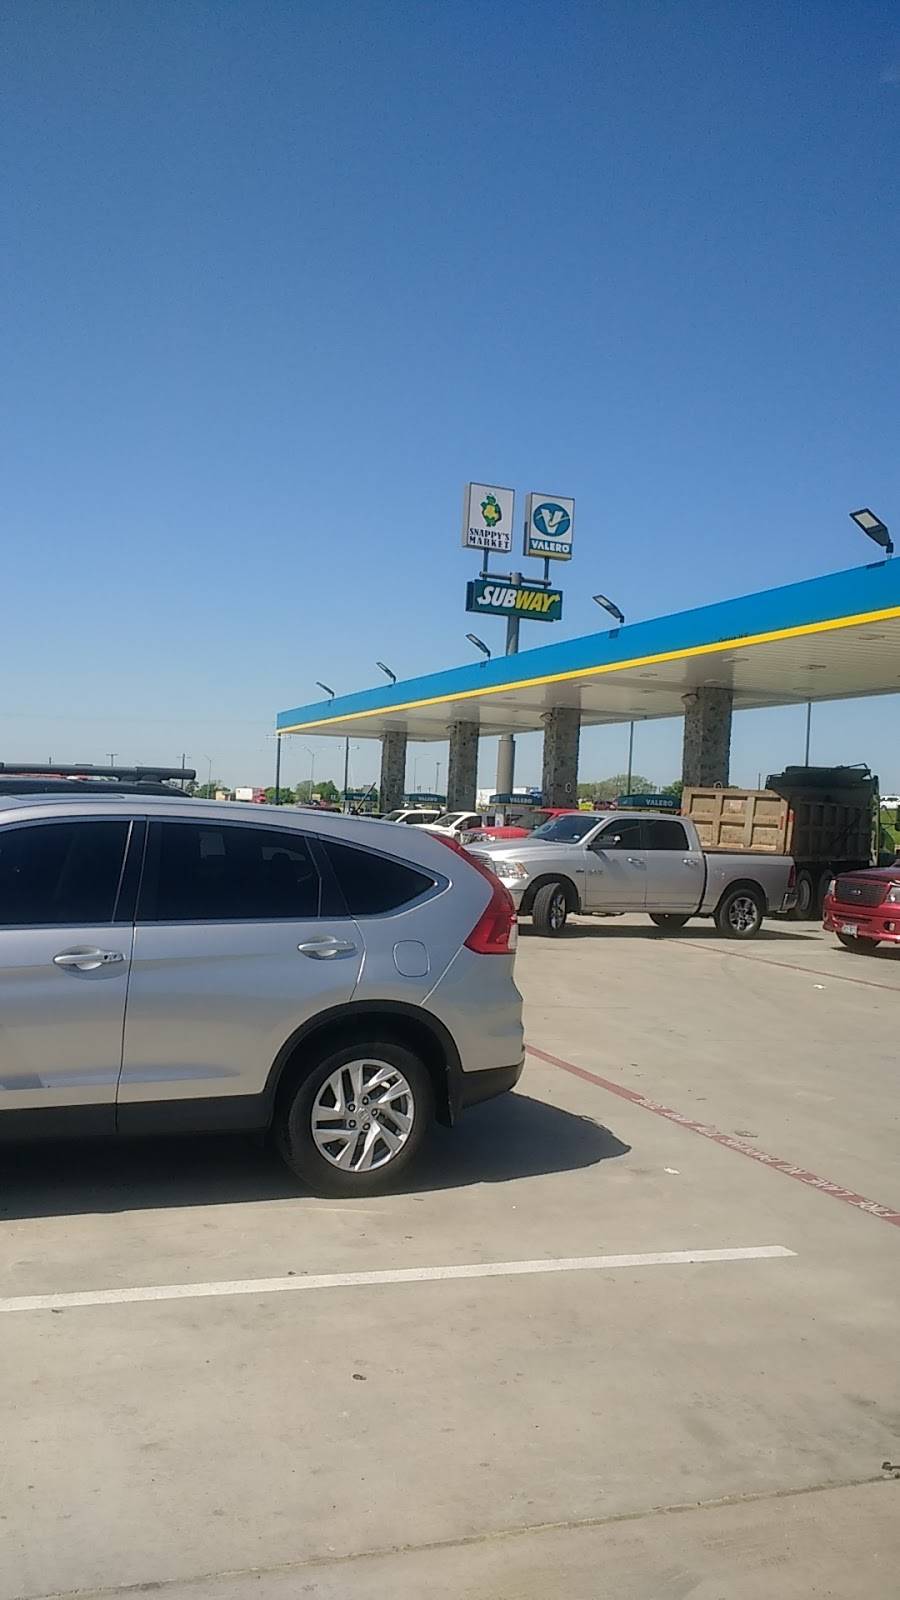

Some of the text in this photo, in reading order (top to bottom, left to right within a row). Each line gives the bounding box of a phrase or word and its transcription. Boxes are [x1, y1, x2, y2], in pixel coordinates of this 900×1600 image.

[469, 527, 510, 541] SNAPPY'S
[469, 535, 510, 549] MARKET
[531, 540, 570, 553] VALERO
[477, 586, 560, 613] SUBWAY
[509, 796, 533, 804] VALERO
[645, 799, 673, 807] VALERO
